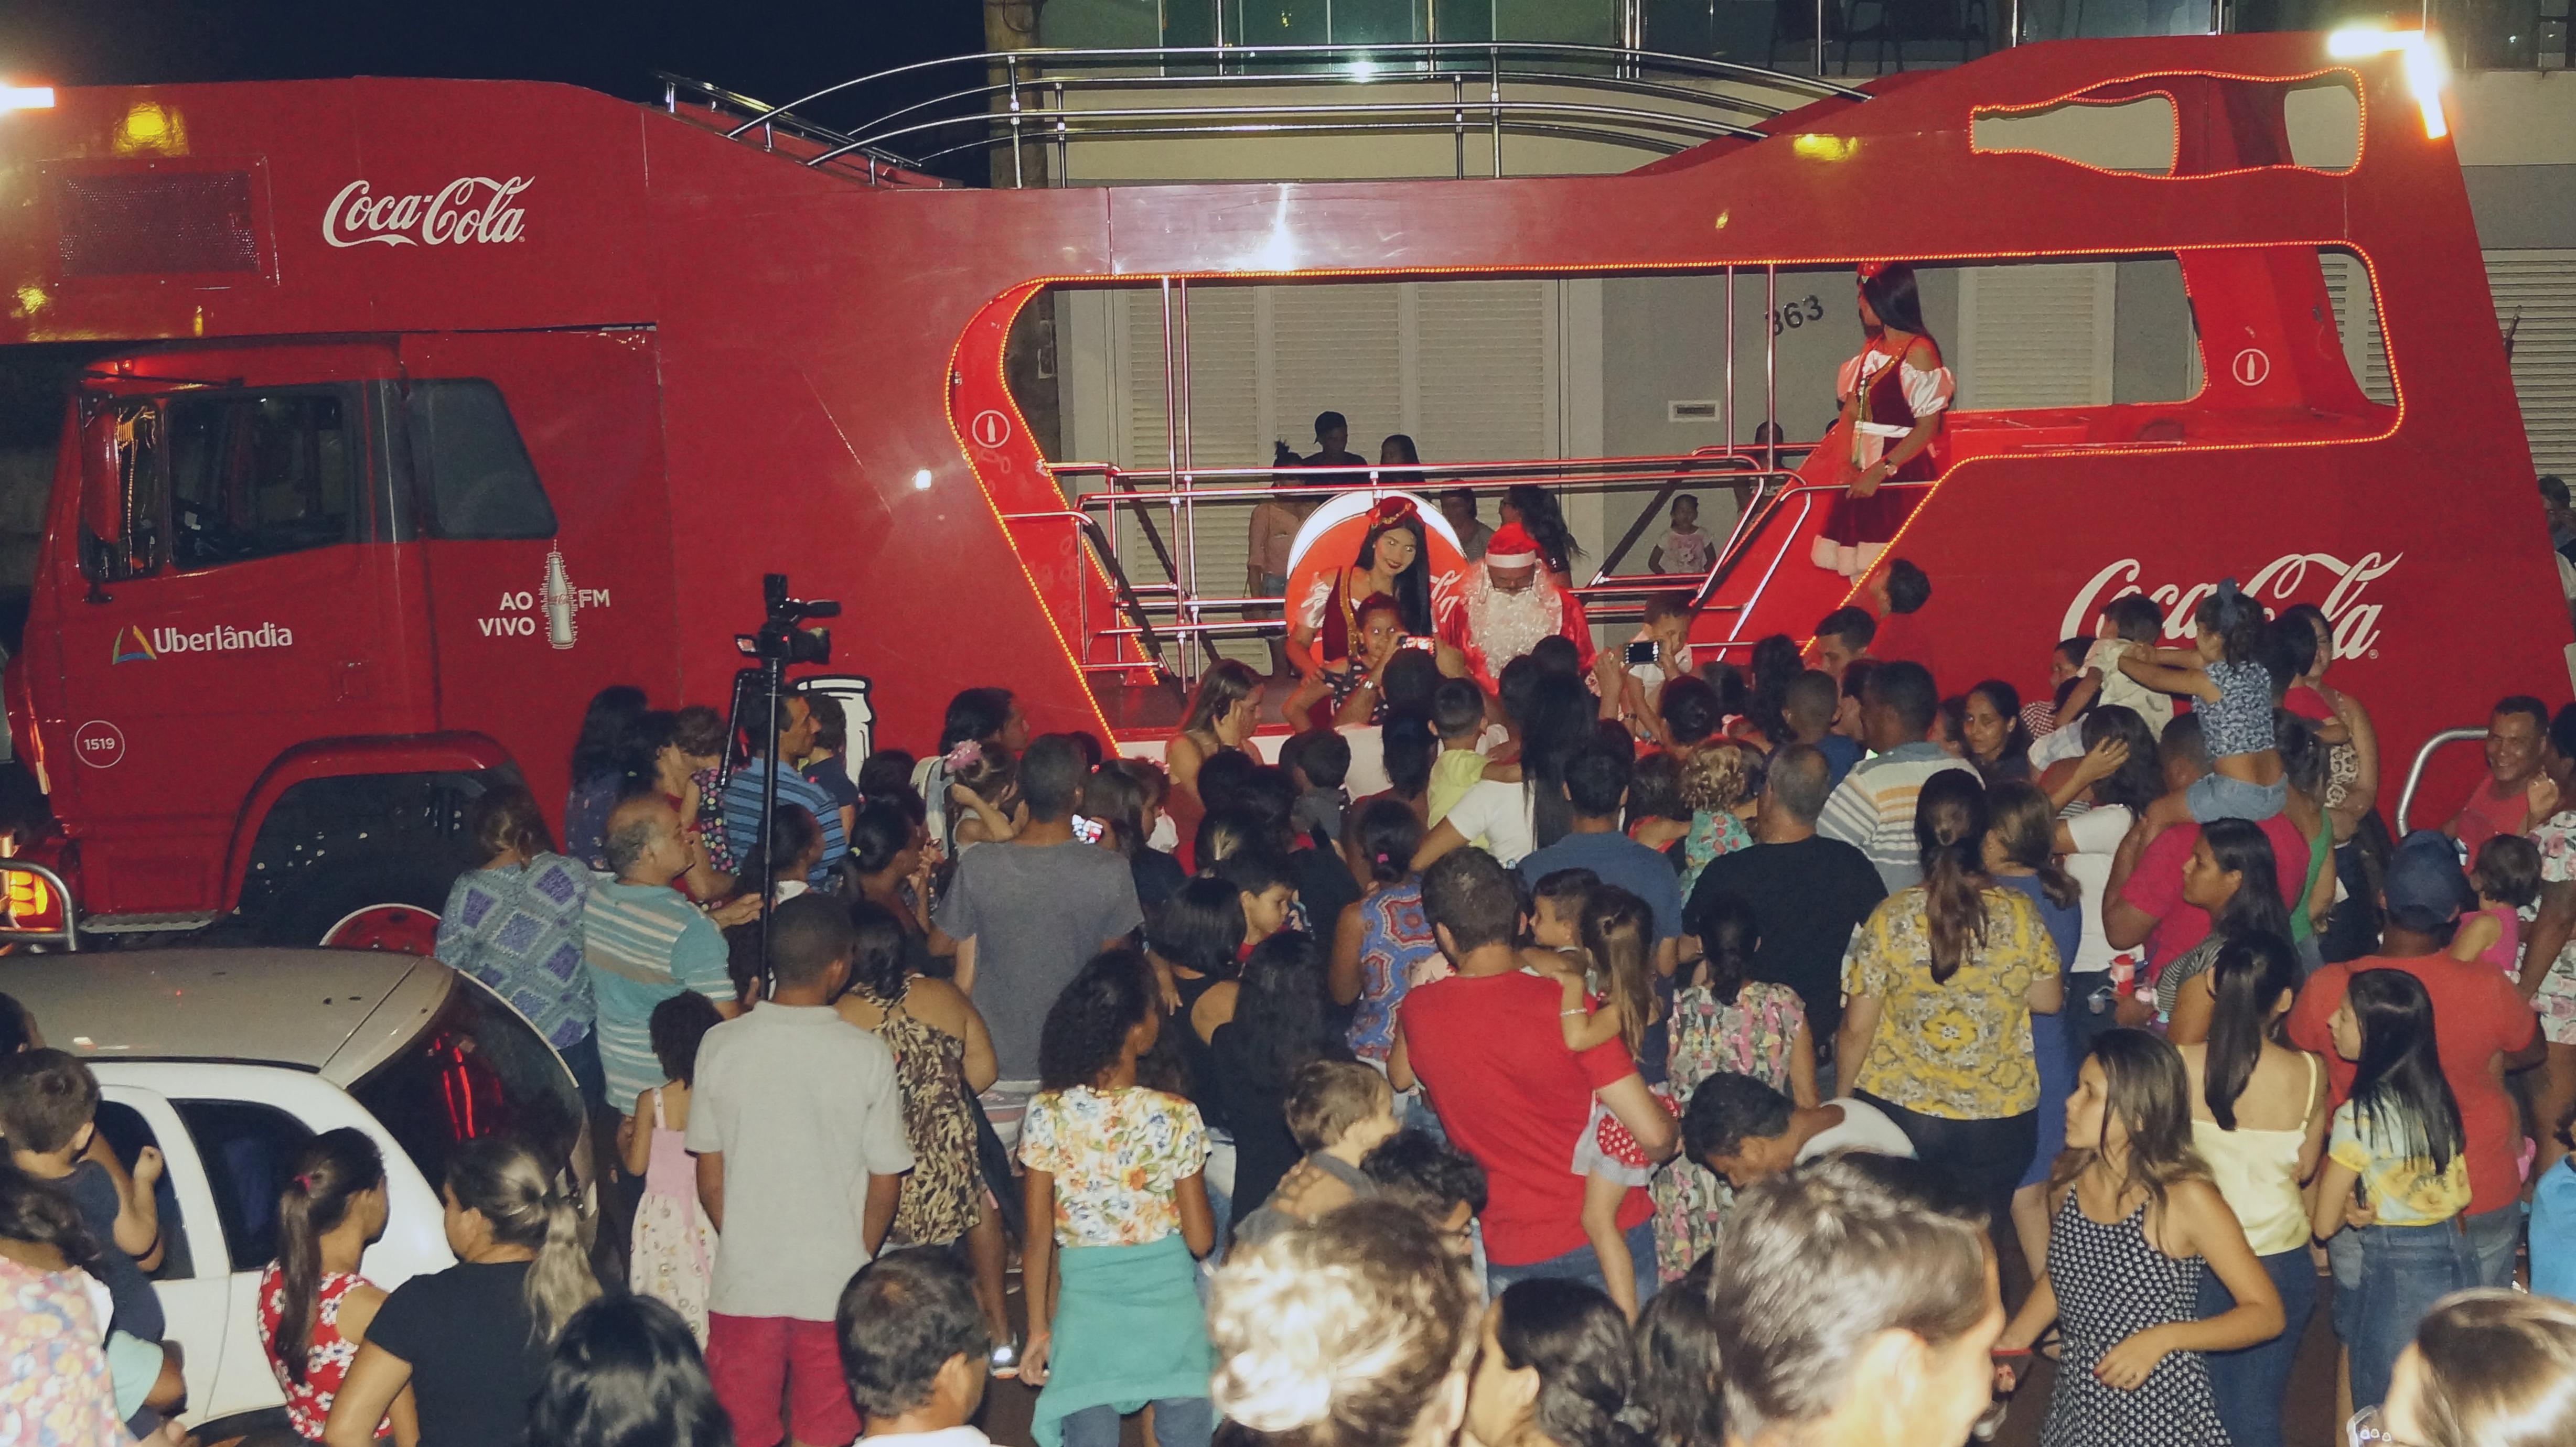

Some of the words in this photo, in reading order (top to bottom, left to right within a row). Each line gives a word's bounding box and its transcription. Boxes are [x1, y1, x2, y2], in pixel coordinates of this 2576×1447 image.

[323, 176, 535, 248] Coca-Cola
[499, 591, 533, 611] AO
[578, 588, 610, 608] FM
[478, 616, 536, 637] VIVO
[153, 621, 293, 654] Uberlândia
[83, 737, 116, 751] 1519
